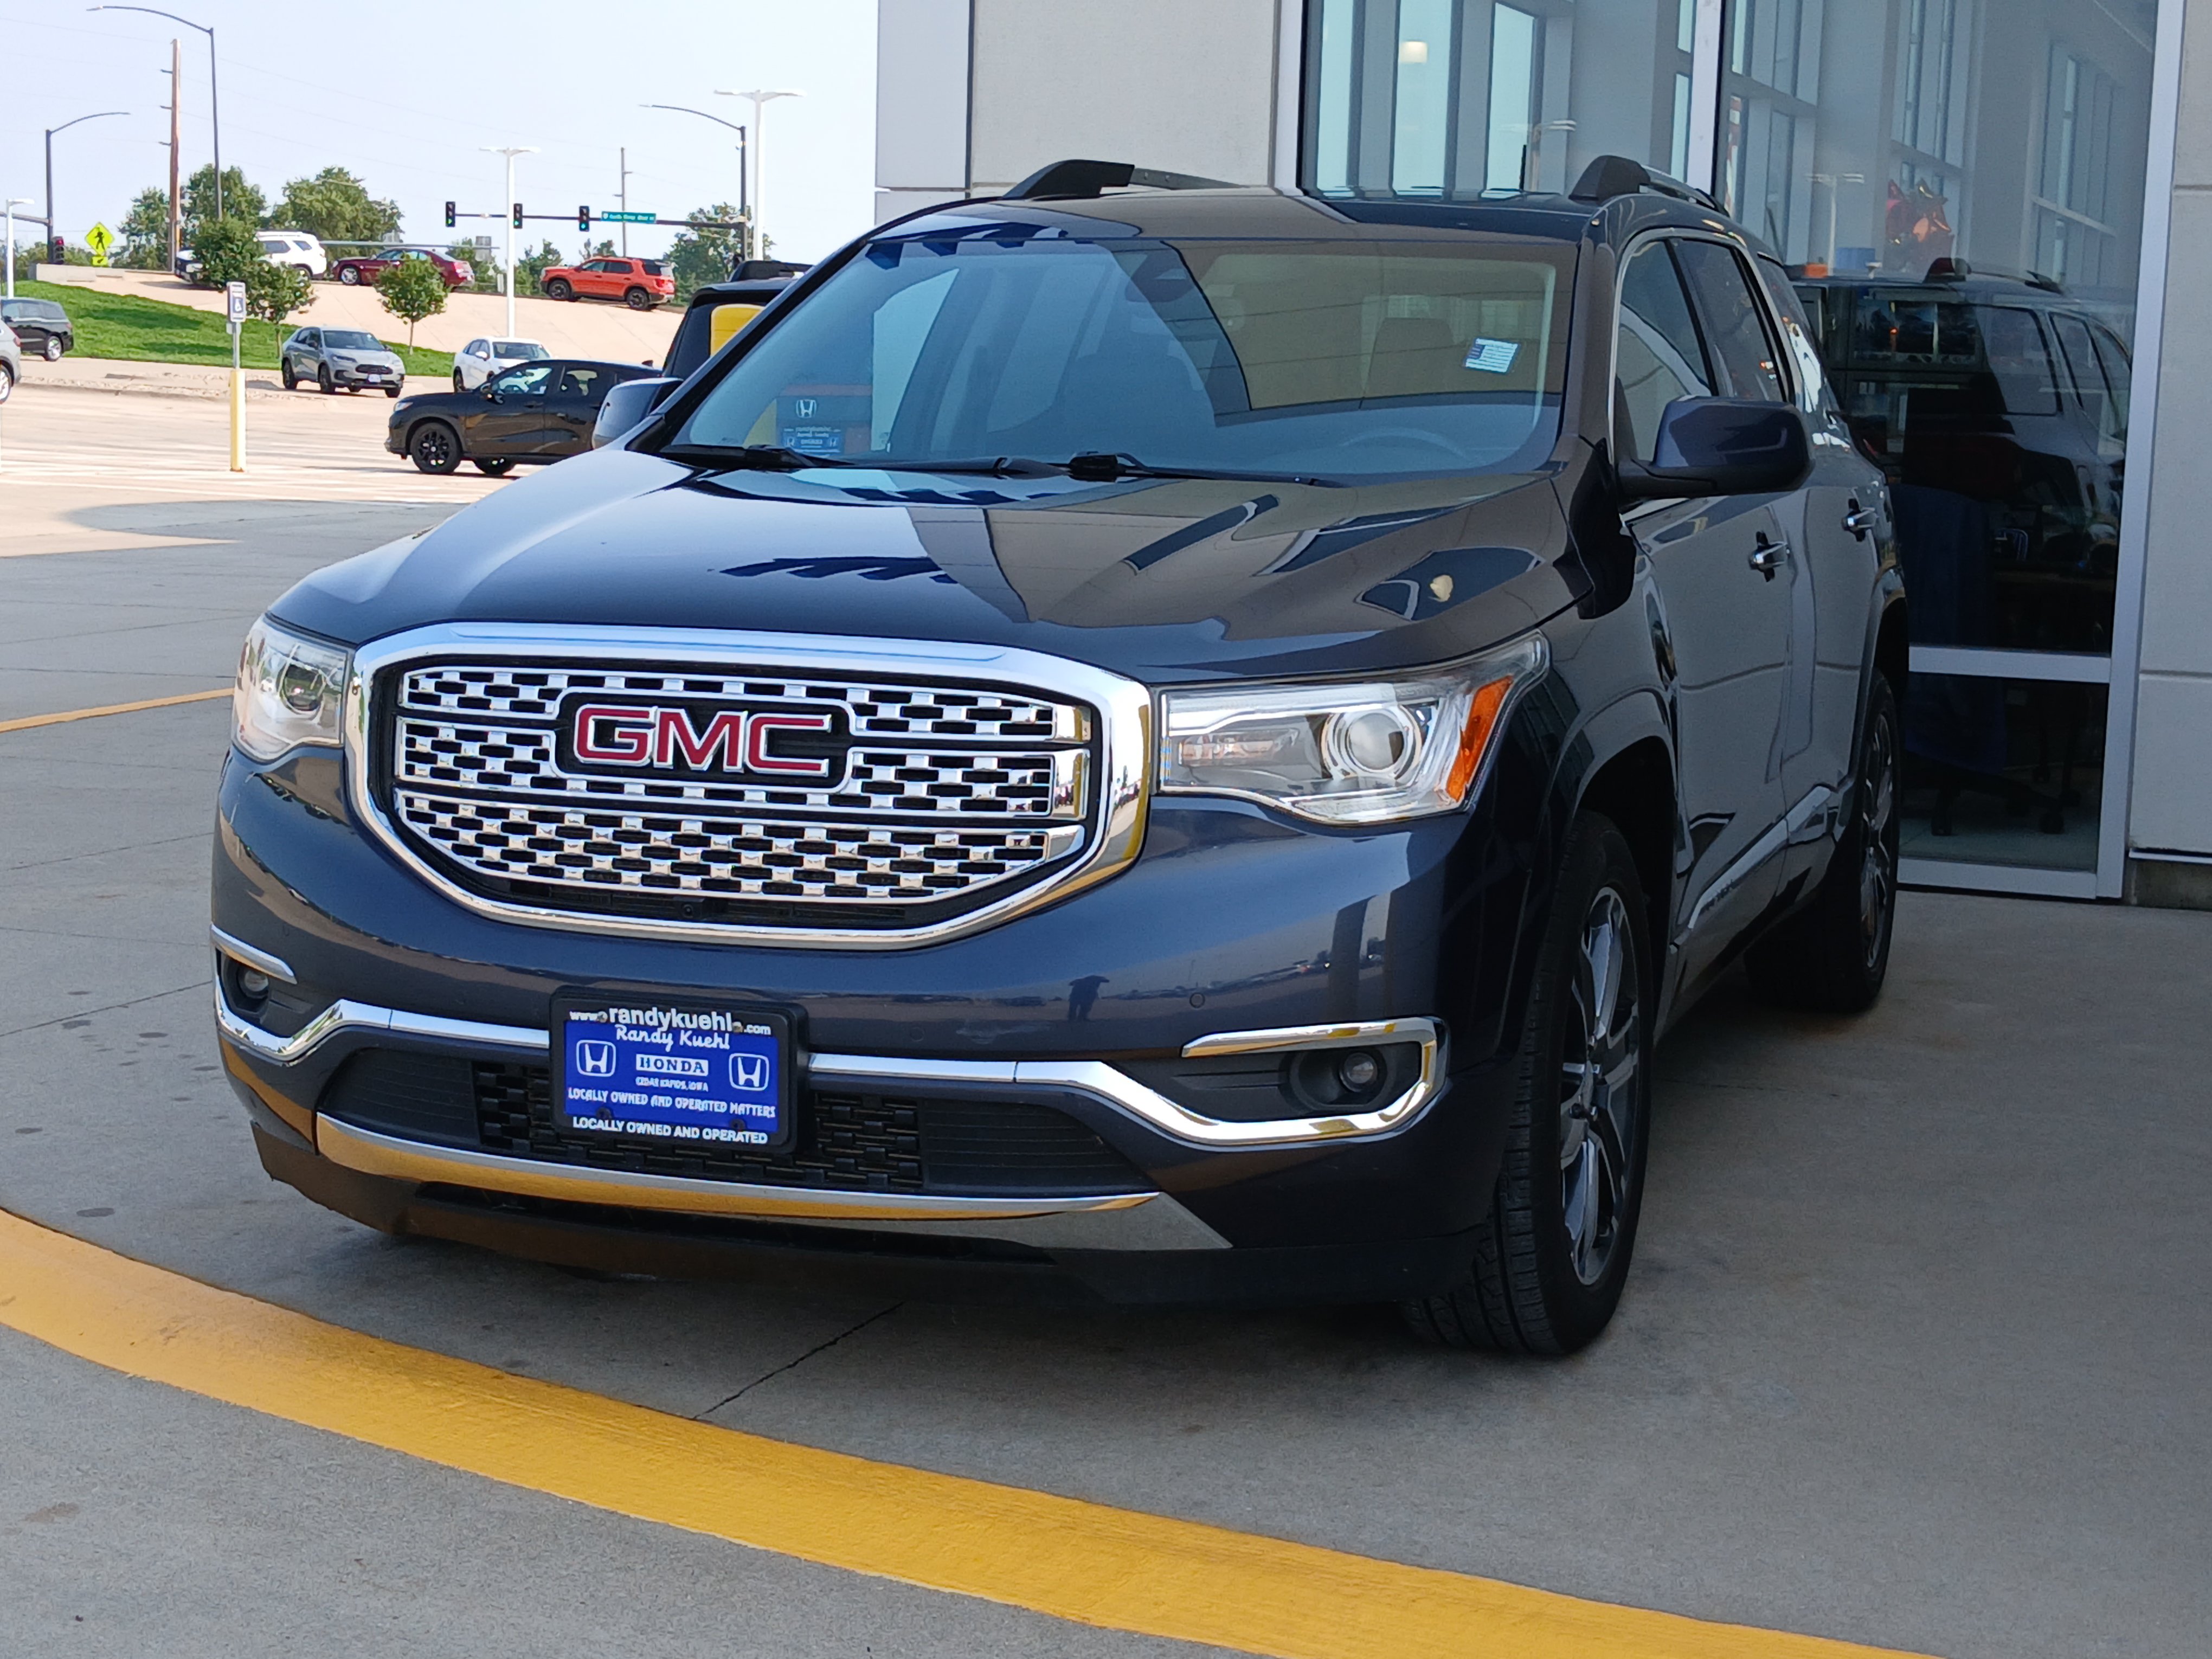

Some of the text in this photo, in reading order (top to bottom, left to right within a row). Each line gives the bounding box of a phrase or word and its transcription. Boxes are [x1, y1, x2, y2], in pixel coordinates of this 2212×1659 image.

[574, 704, 832, 777] GMC
[569, 1007, 771, 1035] wwwrandykuehl.com
[615, 1024, 730, 1052] Randy Kuehl
[640, 1057, 705, 1073] HONDA
[568, 1087, 776, 1118] LOCALLY OWNED AND OPERATED MATTERS
[573, 1116, 768, 1144] LOCALLY OWNED AND OPERATED
